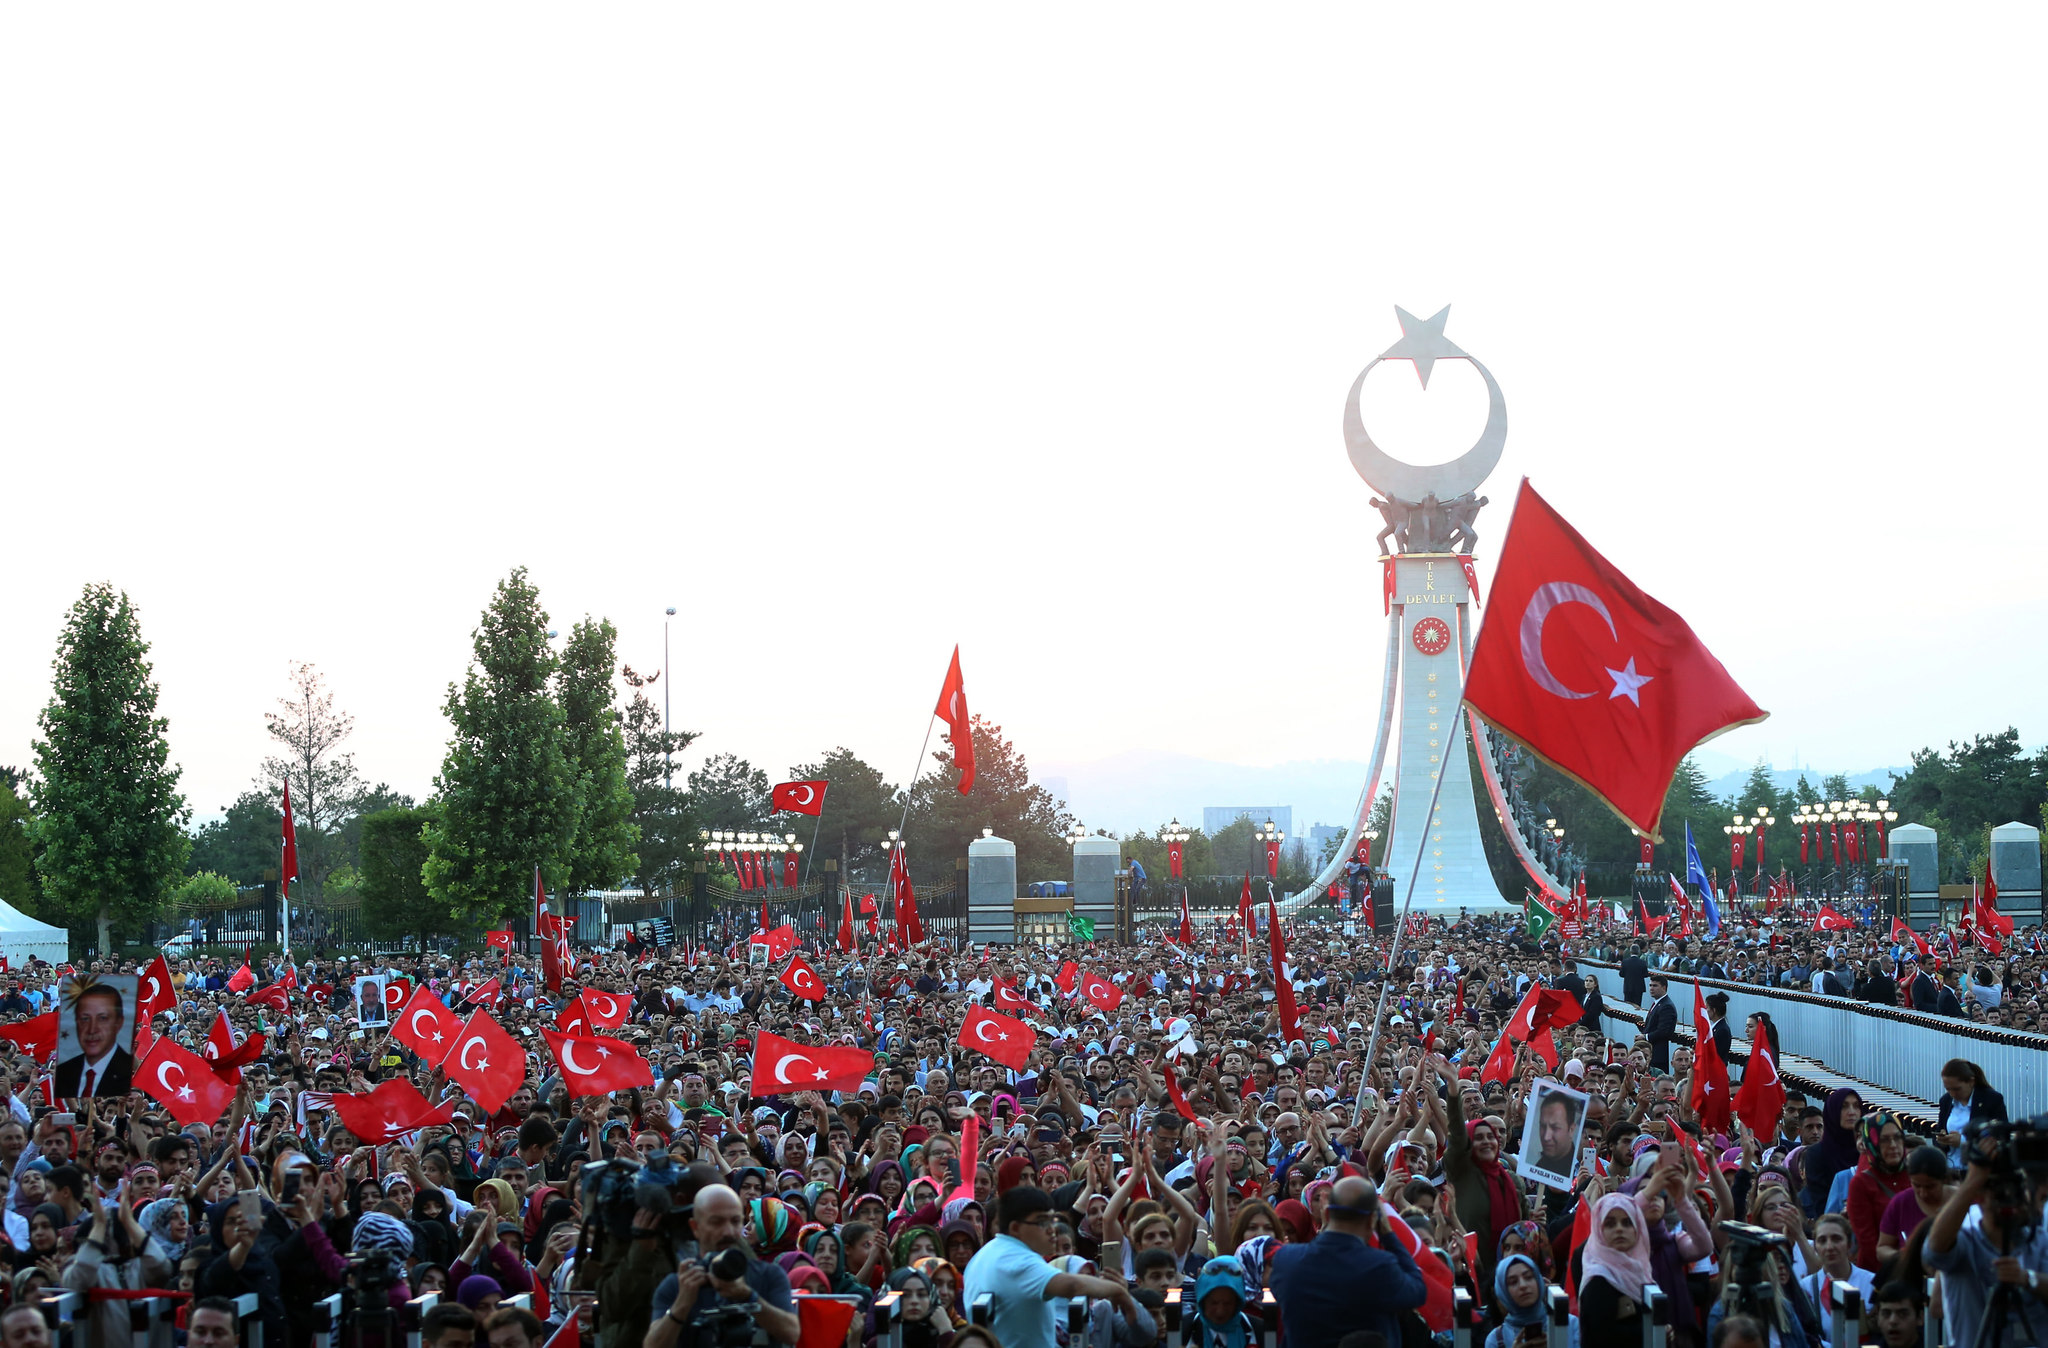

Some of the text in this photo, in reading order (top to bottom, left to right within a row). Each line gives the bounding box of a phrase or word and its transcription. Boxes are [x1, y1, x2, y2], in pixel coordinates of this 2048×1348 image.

[1425, 561, 1435, 591] TEK
[1406, 594, 1456, 604] DEVLET
[720, 1002, 738, 1012] IST
